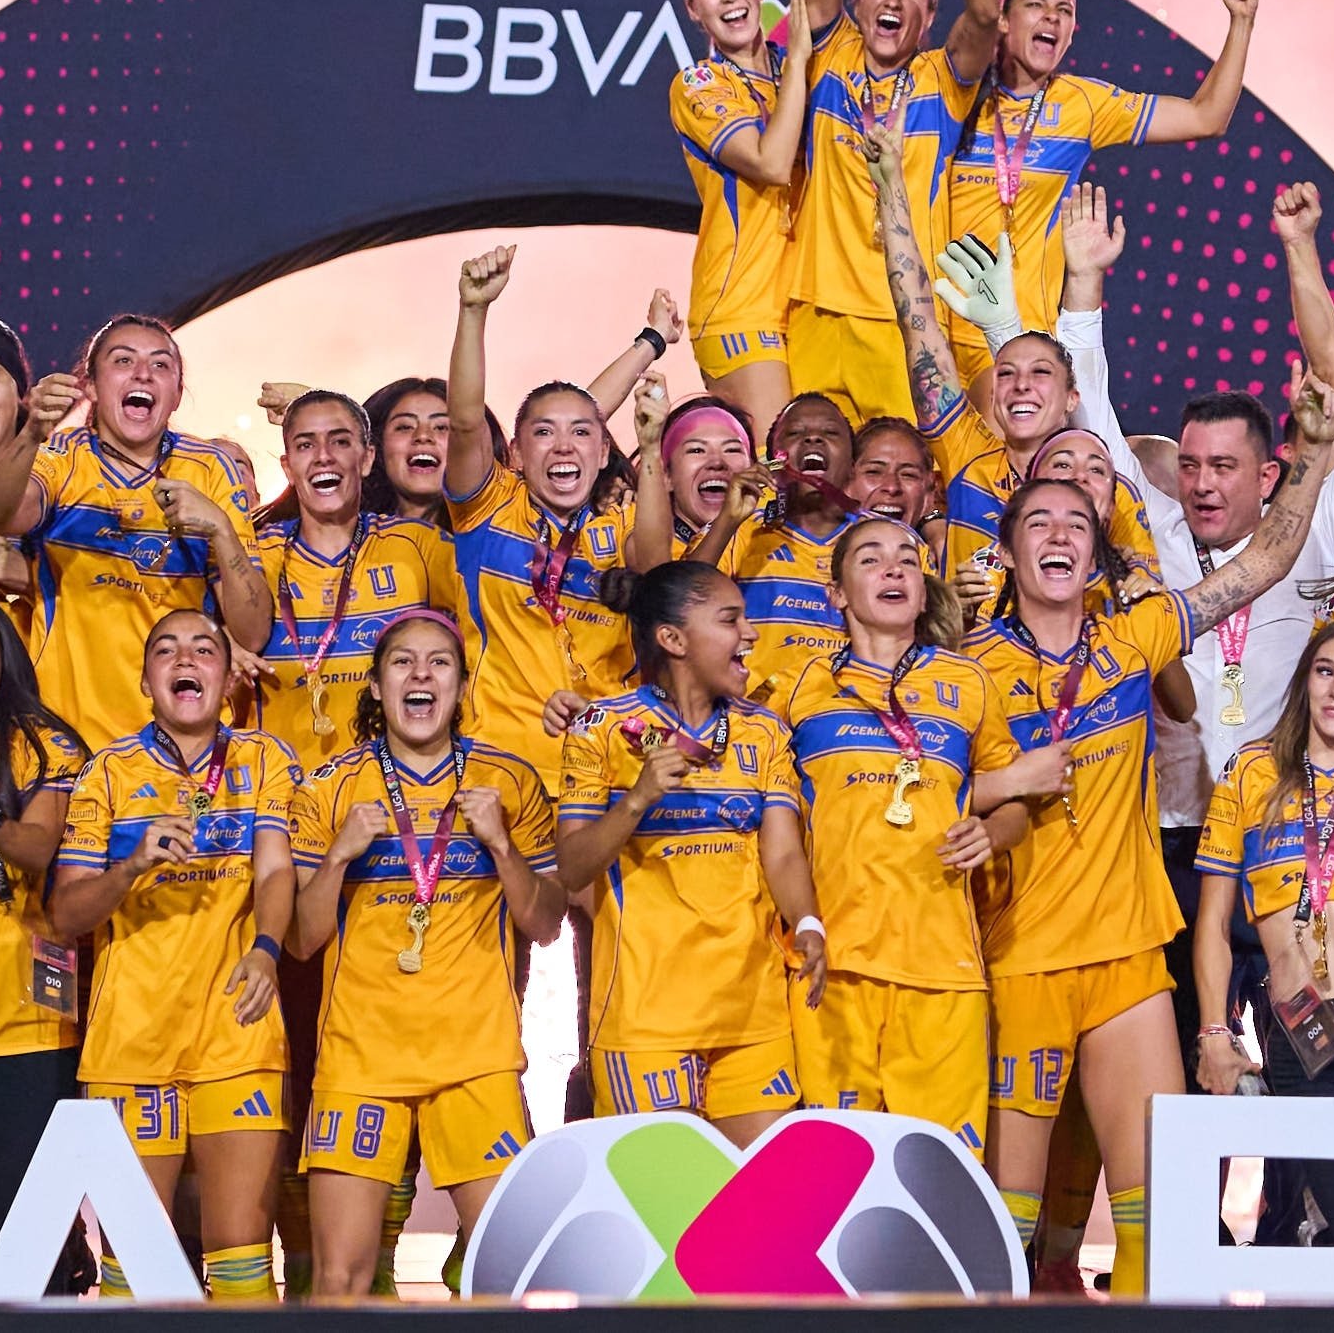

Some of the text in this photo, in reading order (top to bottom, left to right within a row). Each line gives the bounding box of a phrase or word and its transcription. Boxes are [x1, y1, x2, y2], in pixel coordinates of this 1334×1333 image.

[414, 0, 695, 96] BBVA
[586, 524, 617, 556] U
[367, 564, 397, 597] U
[785, 598, 827, 612] CEMEX
[1076, 645, 1089, 666] LIGA
[1090, 645, 1122, 681] U
[933, 680, 960, 710] U
[717, 717, 728, 743] BBVA
[849, 726, 889, 737] CEME
[732, 743, 759, 774] U
[224, 765, 252, 794] U
[379, 748, 405, 812] LIGA BBVA
[664, 808, 708, 820] CEMEX
[1304, 805, 1315, 828] LIGA
[443, 849, 478, 864] ertua
[45, 976, 62, 989] 010
[1307, 1022, 1324, 1041] 004
[643, 1068, 681, 1109] U
[1028, 1047, 1065, 1102] 12
[133, 1084, 180, 1140] 31
[312, 1103, 386, 1160] U 8
